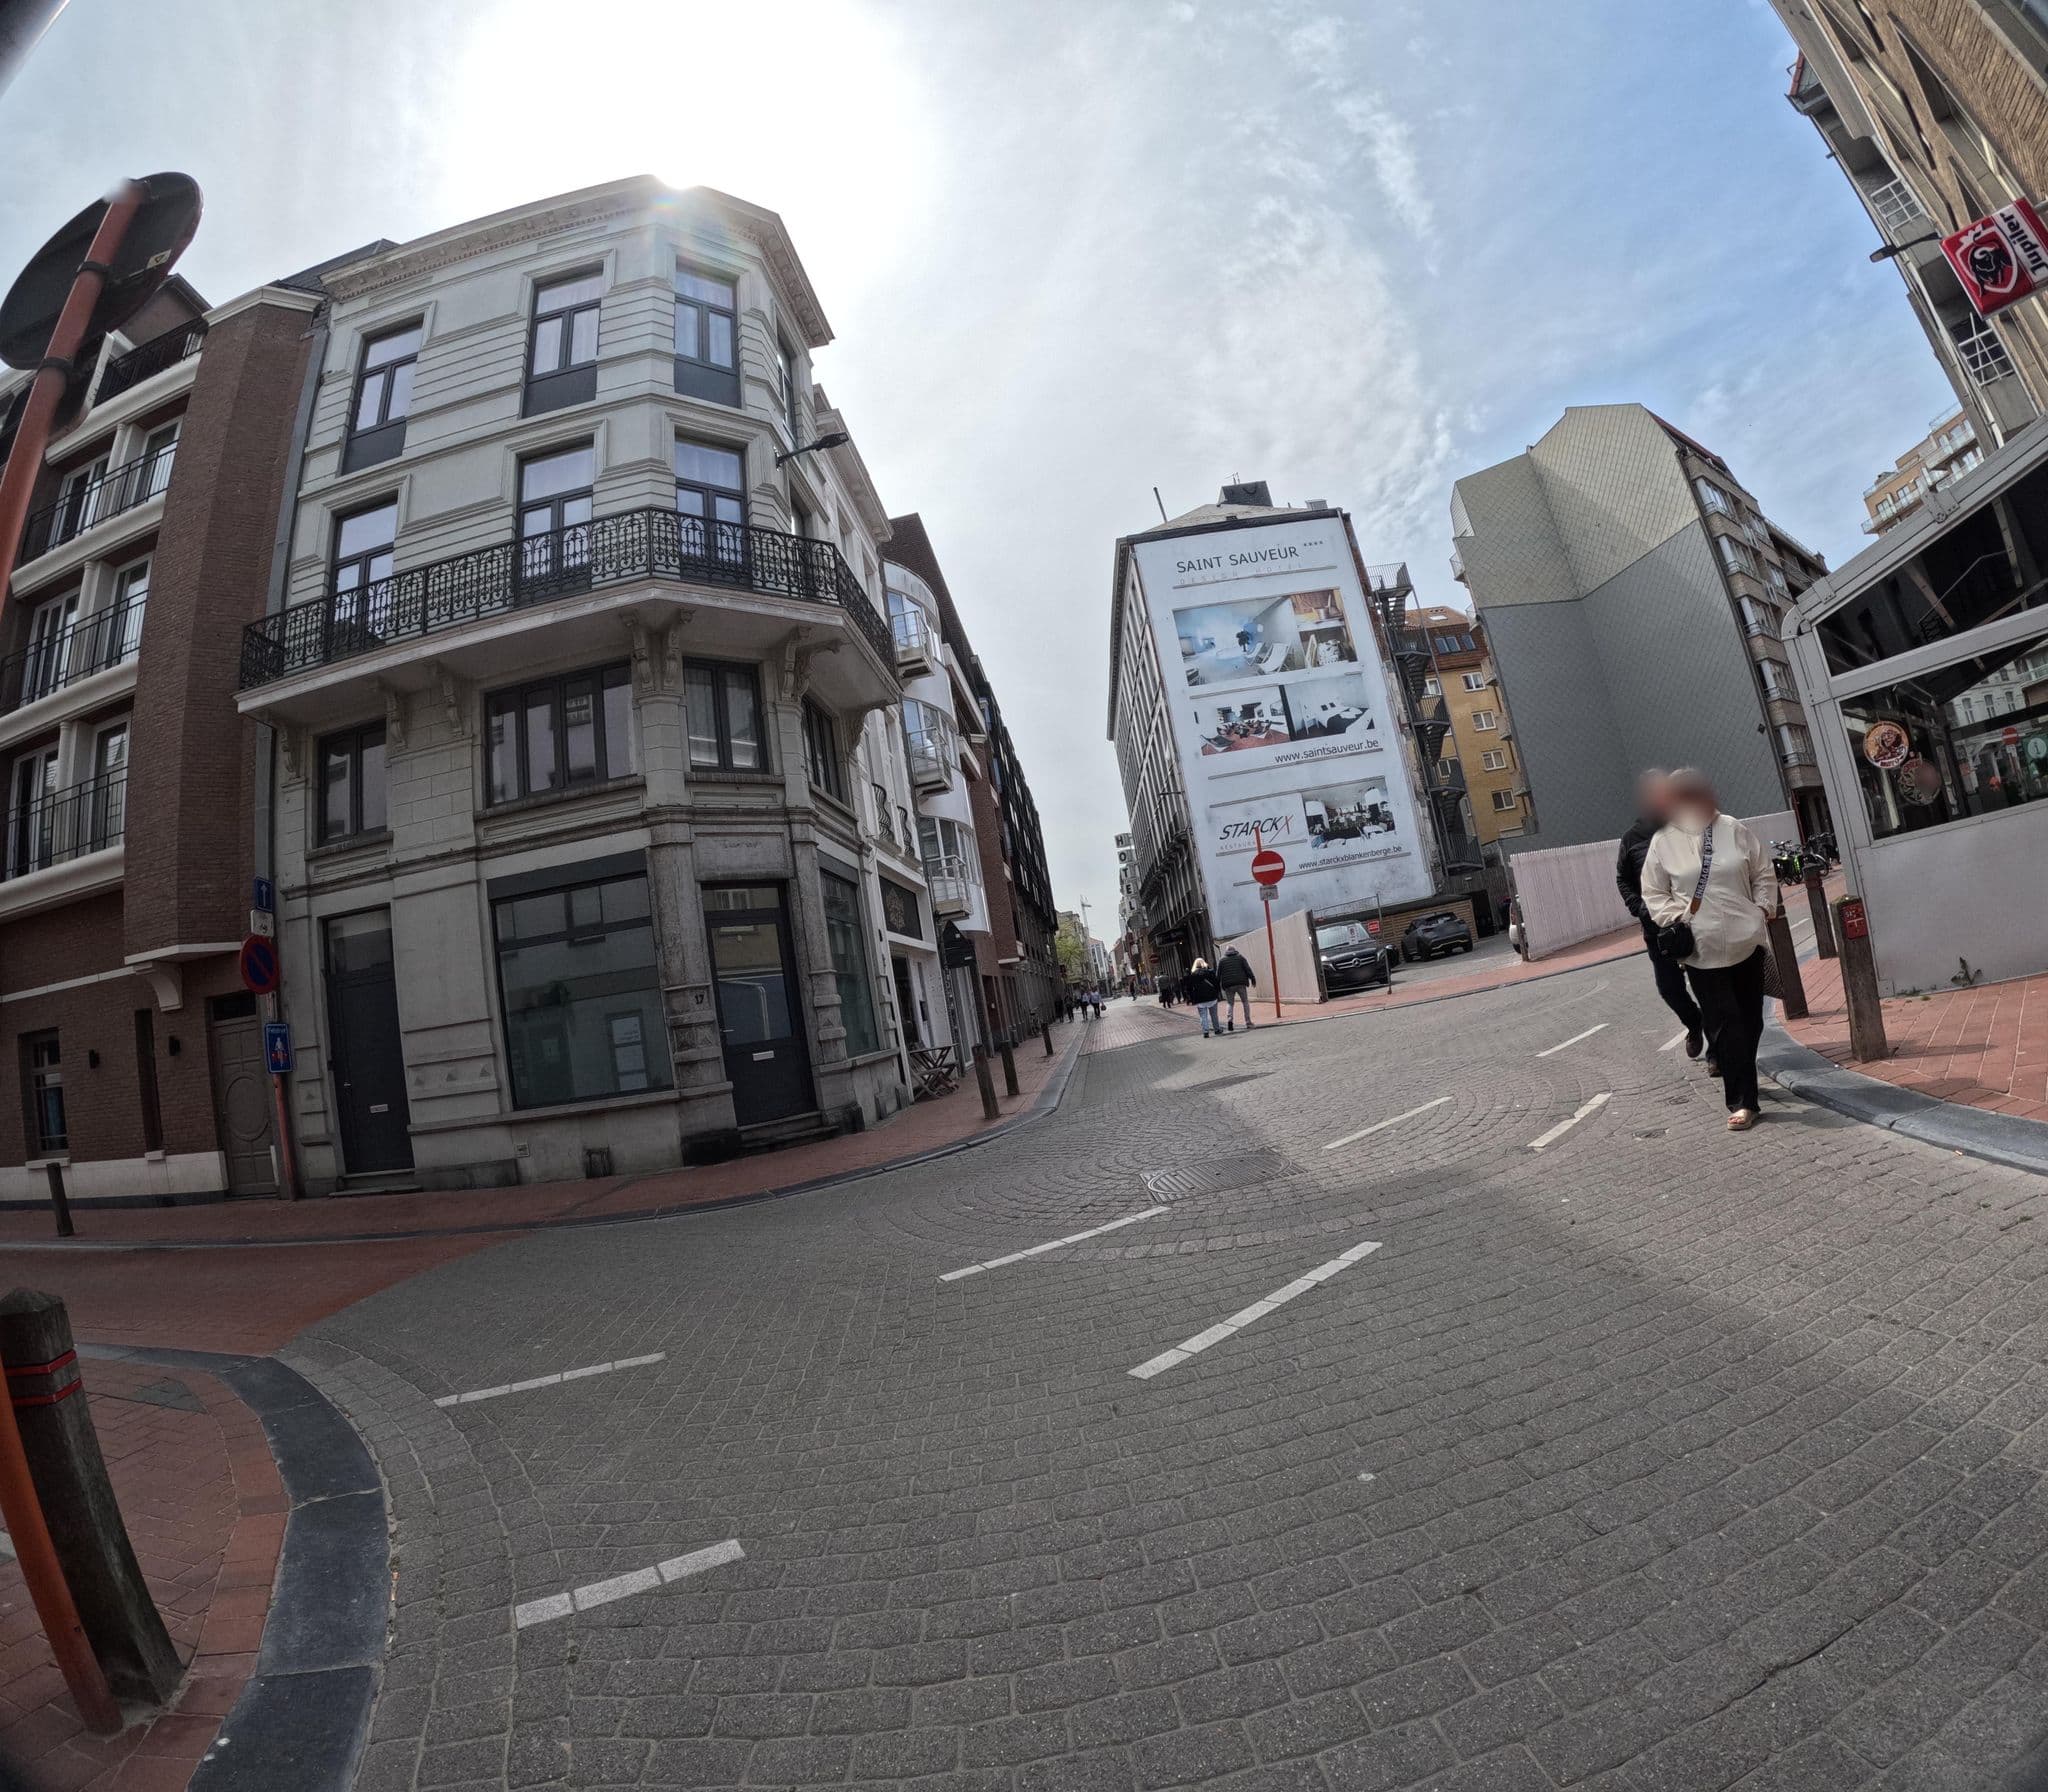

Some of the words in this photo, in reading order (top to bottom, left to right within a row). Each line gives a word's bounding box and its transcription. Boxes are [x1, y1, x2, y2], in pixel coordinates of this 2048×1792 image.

[2000, 213, 2048, 275] Jupiler
[1176, 556, 1222, 574] SAINT
[1228, 546, 1300, 566] SAUVEUR
[1274, 739, 1379, 763] www.saintsauveur.be
[1298, 845, 1402, 870] www.starckxblankenberge.be
[1116, 835, 1135, 911] HOTEL
